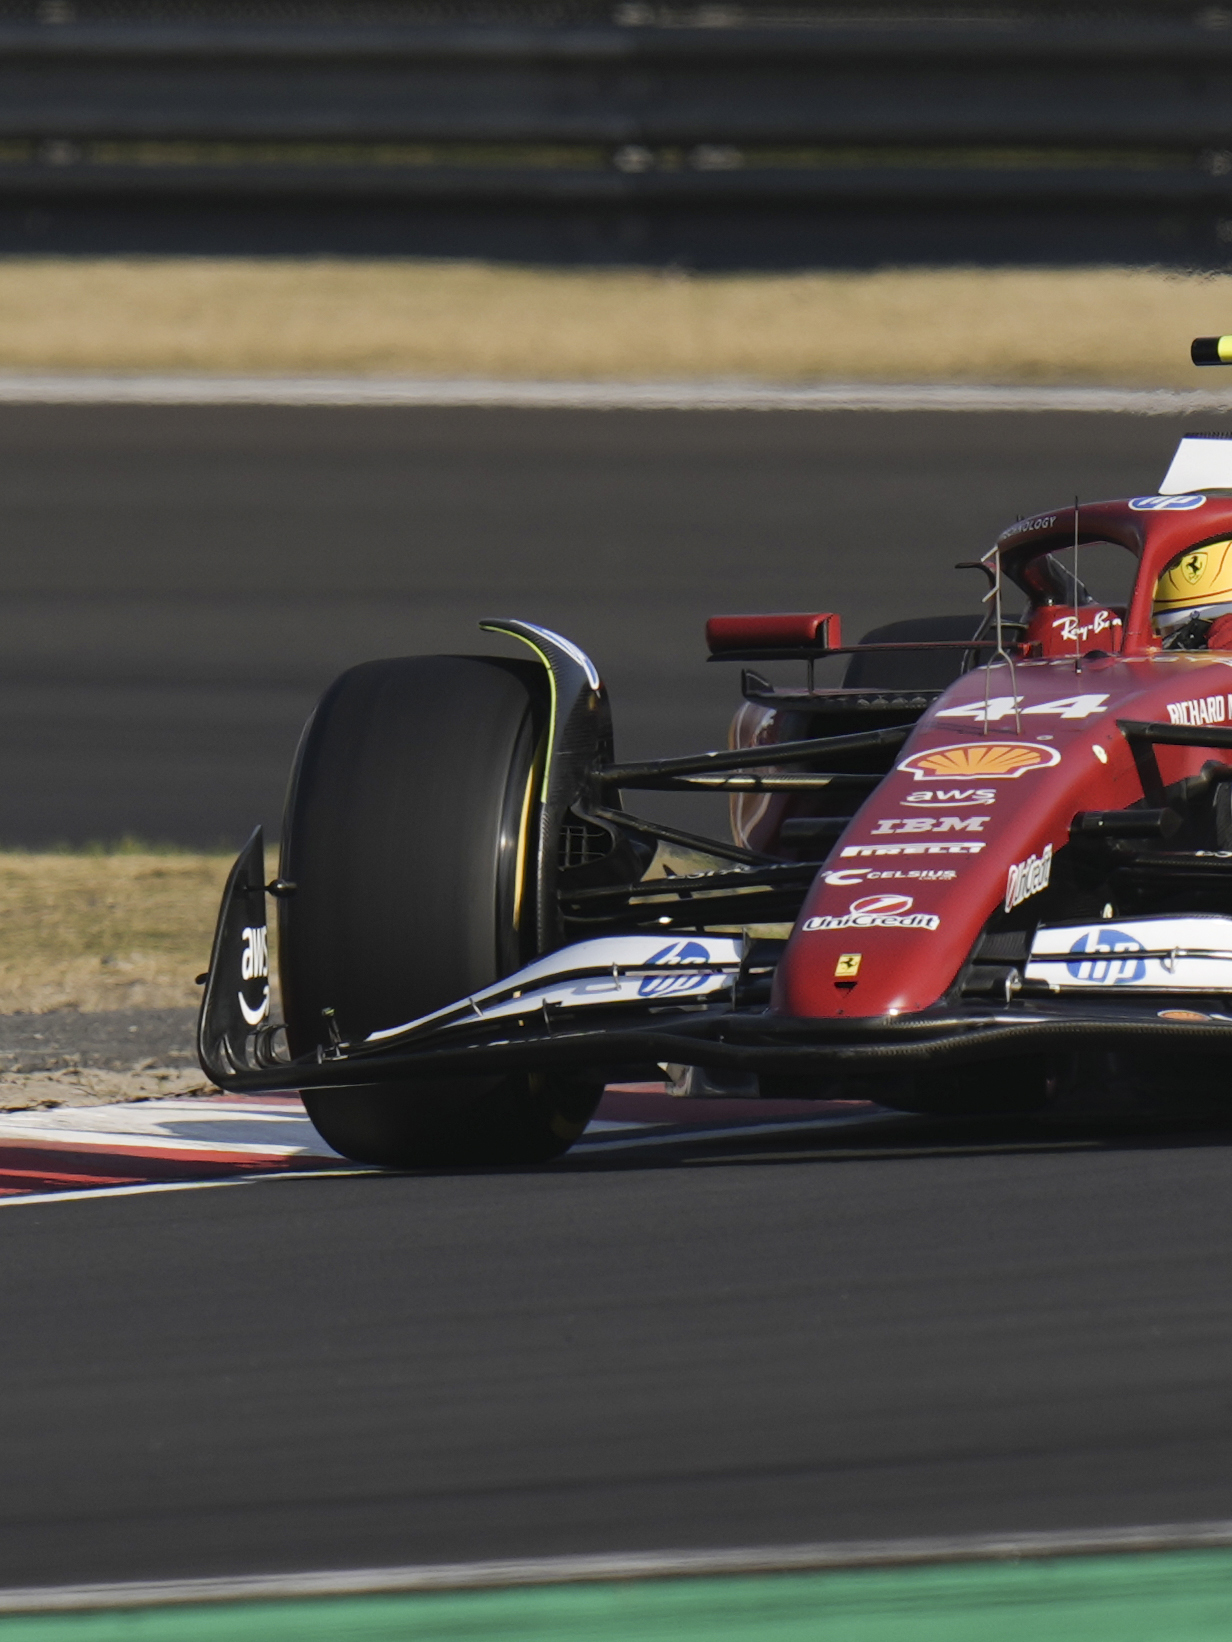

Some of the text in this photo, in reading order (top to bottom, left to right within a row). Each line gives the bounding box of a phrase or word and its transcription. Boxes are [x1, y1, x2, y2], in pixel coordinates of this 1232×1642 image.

[1052, 610, 1122, 641] Ray-Ban
[935, 693, 1110, 721] 44
[1166, 696, 1225, 726] RICHARD
[905, 788, 997, 802] aws
[870, 816, 991, 835] IBM
[840, 842, 987, 857] PIRELLI
[866, 870, 956, 880] CELSIUS
[803, 913, 940, 931] UniCredit
[641, 942, 708, 997] hp
[1077, 930, 1141, 986] hp
